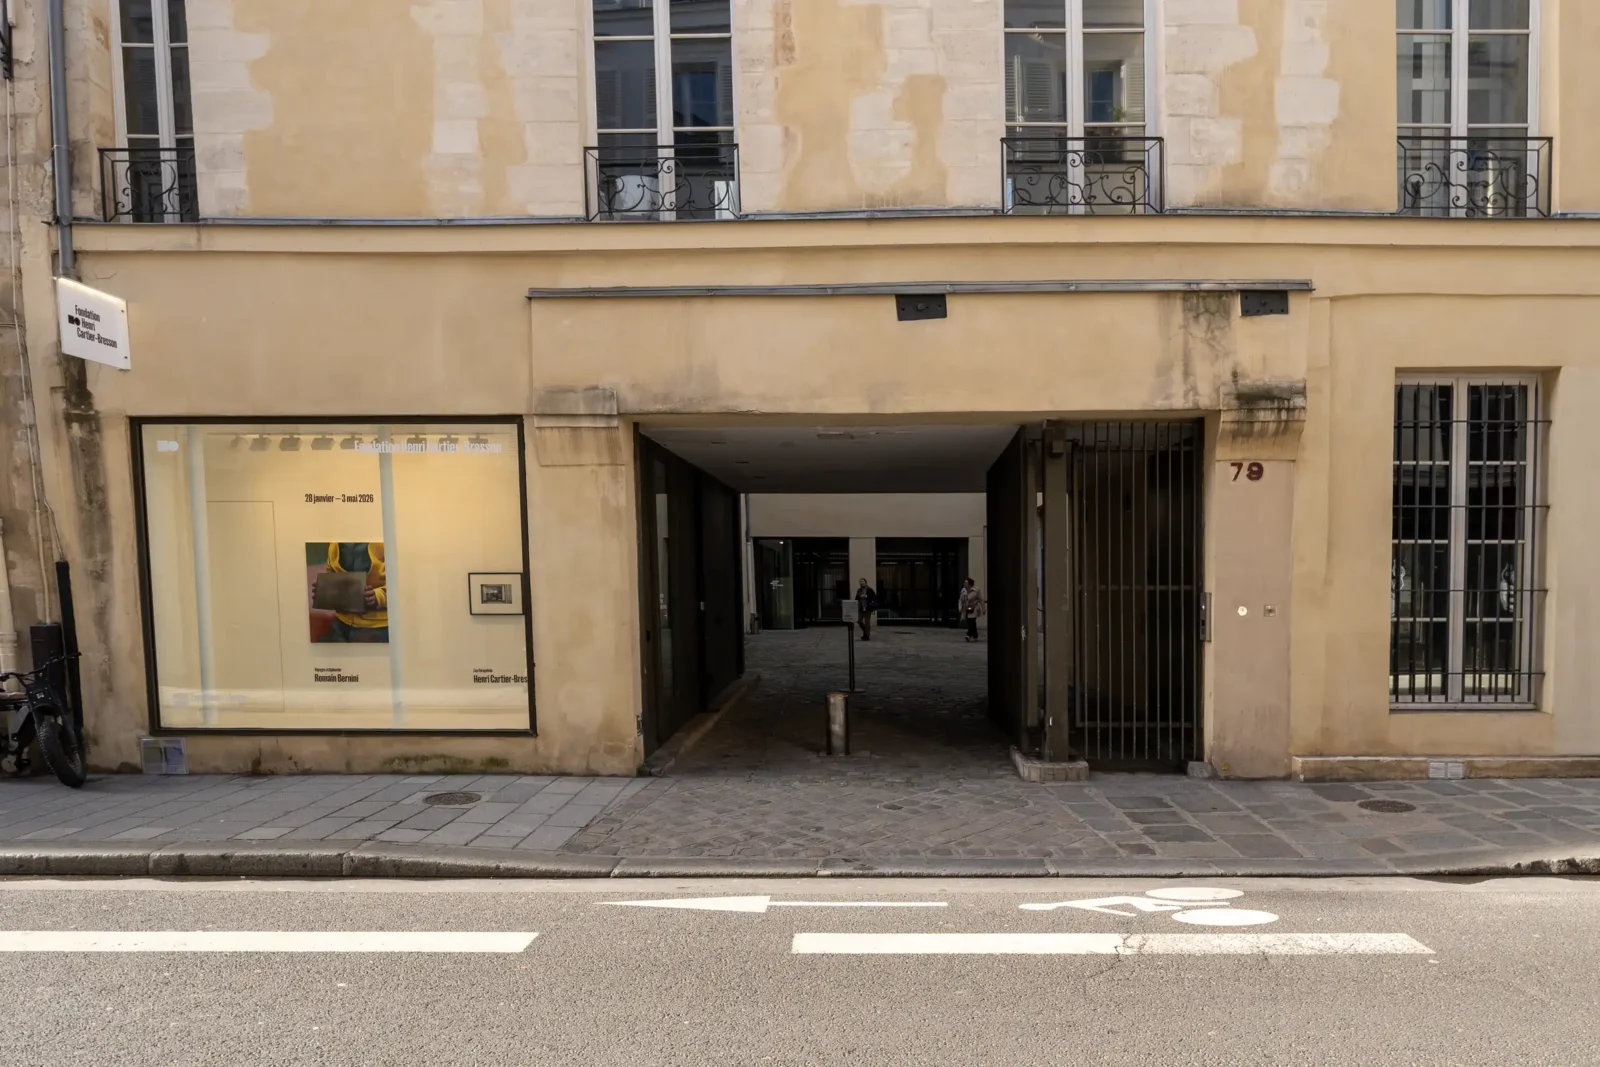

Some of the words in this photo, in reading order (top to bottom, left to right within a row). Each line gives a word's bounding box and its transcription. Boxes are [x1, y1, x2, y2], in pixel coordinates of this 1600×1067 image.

[75, 305, 100, 322] Fondation
[82, 319, 95, 331] Henri
[77, 327, 117, 348] Cartier-Bresson
[1230, 462, 1264, 482] 79
[305, 494, 313, 503] 28
[313, 494, 335, 505] janvier
[341, 494, 346, 503] 3
[346, 494, 358, 503] mai
[358, 494, 374, 503] 2026
[315, 674, 337, 682] Romain
[337, 674, 359, 682] Bernini
[473, 675, 490, 683] Henri
